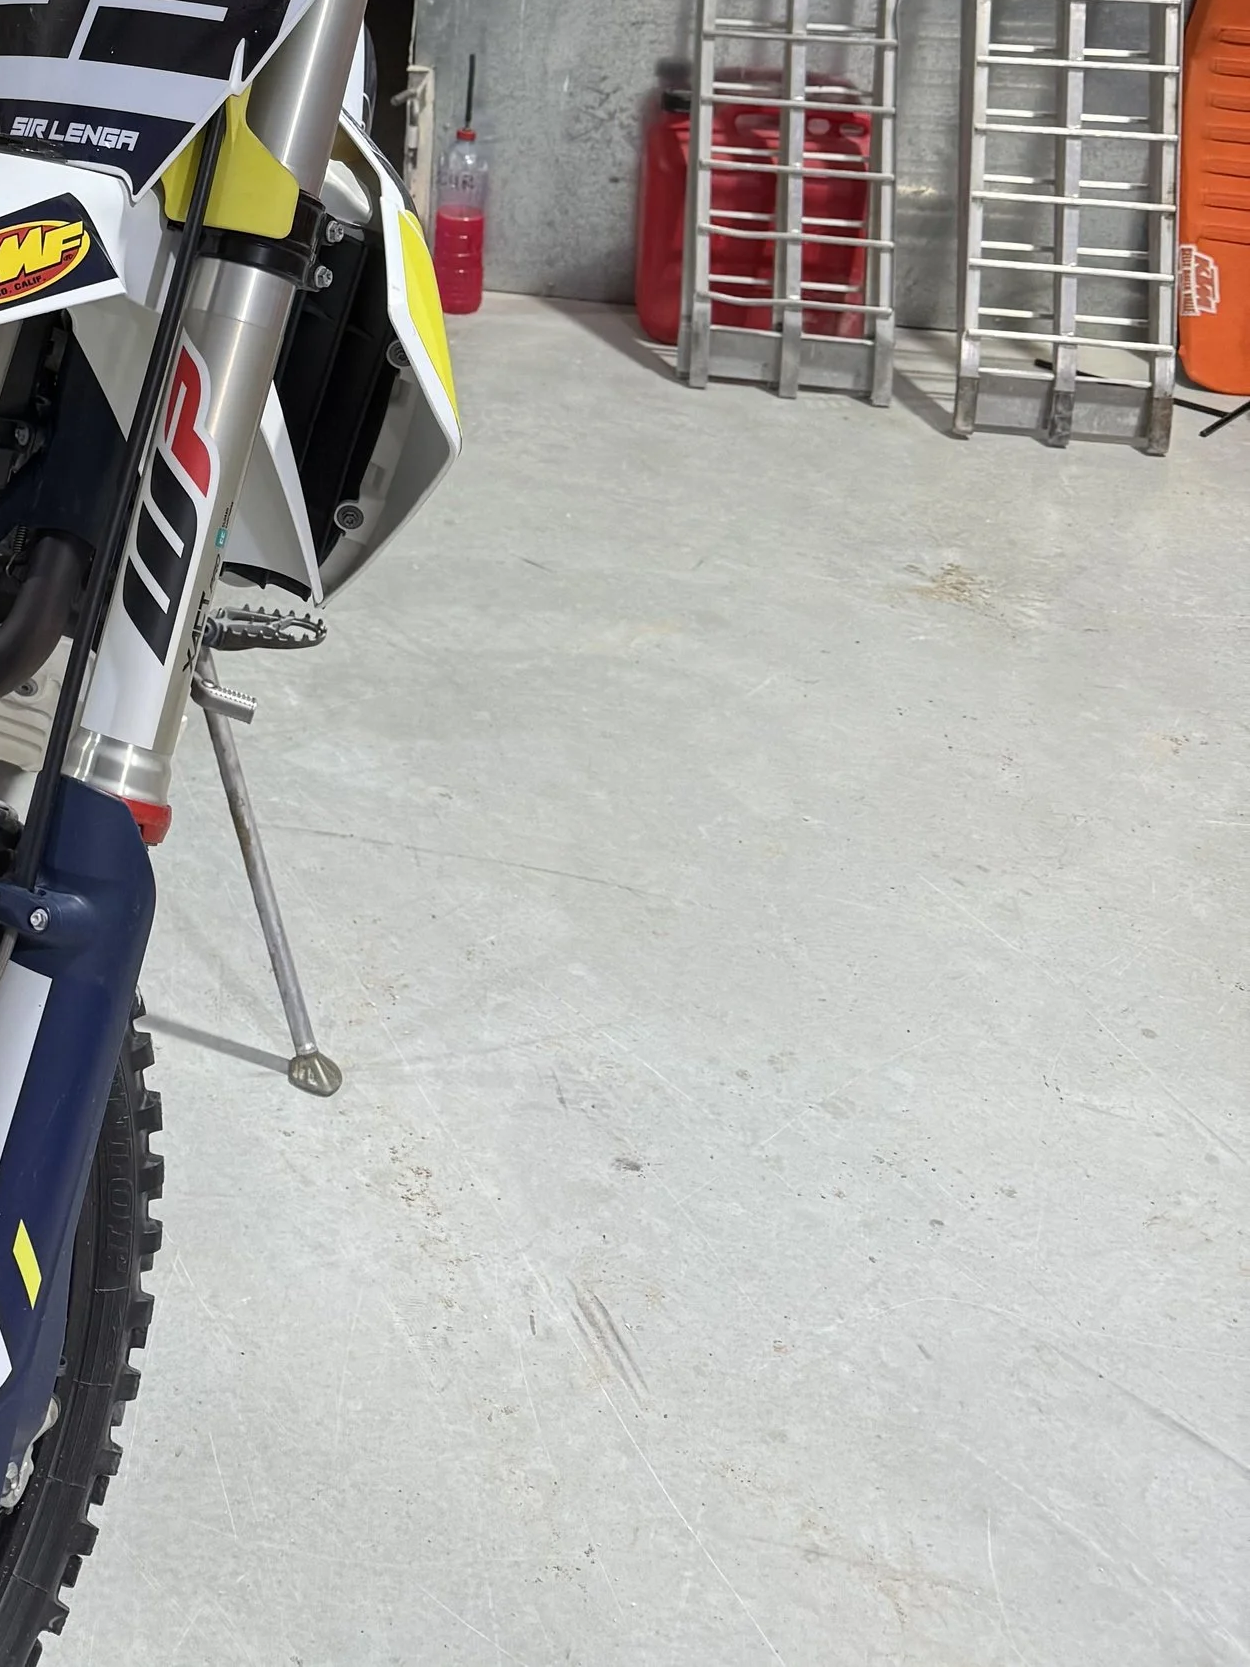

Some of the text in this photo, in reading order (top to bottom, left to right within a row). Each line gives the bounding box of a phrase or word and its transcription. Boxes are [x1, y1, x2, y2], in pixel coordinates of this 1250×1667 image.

[9, 116, 140, 152] SIR LENGA
[14, 275, 47, 291] CALIF.
